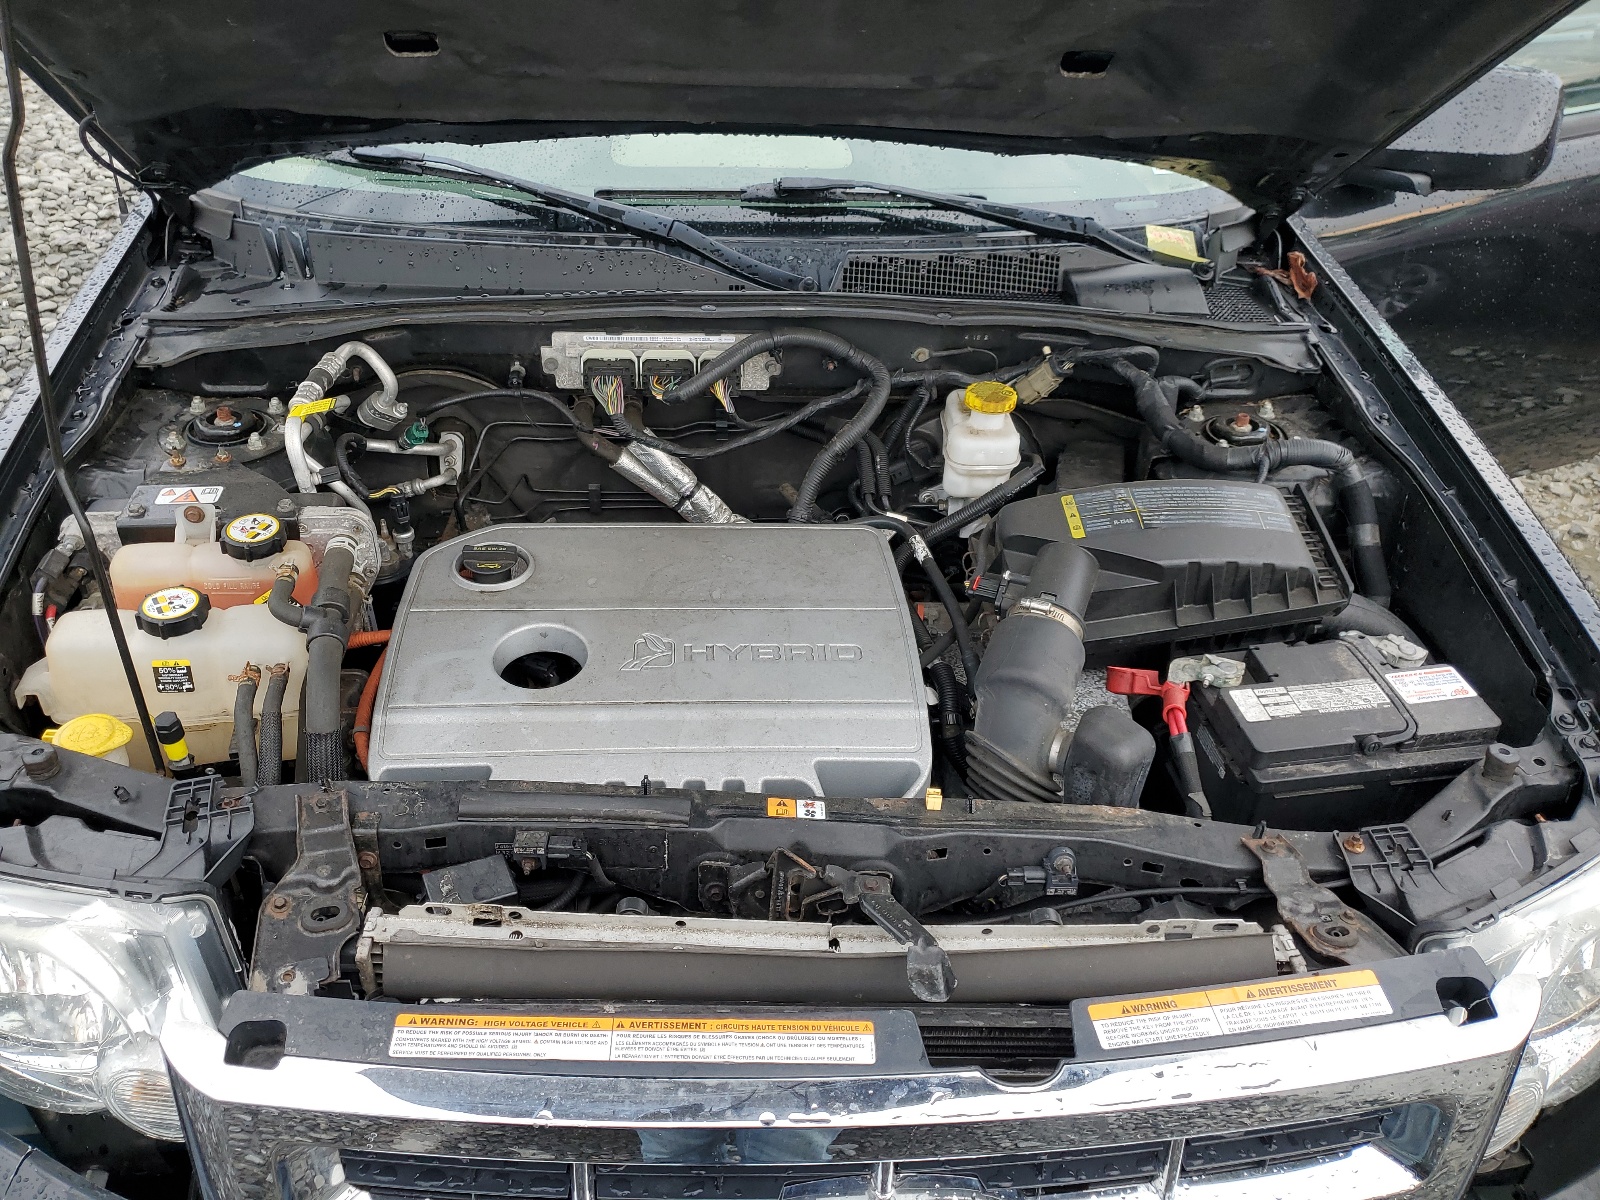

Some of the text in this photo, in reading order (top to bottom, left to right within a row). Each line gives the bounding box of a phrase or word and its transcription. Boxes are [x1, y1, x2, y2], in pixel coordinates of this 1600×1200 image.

[683, 643, 863, 661] HYBRID
[1258, 979, 1338, 997] AVERTISSEMENT
[1130, 1000, 1178, 1013] WARNING
[420, 1017, 479, 1026] WARNING:
[509, 1020, 549, 1028] VOLTAGE
[629, 1021, 708, 1030] AVERTISSEMENT
[823, 1023, 860, 1032] VÉHICULE
